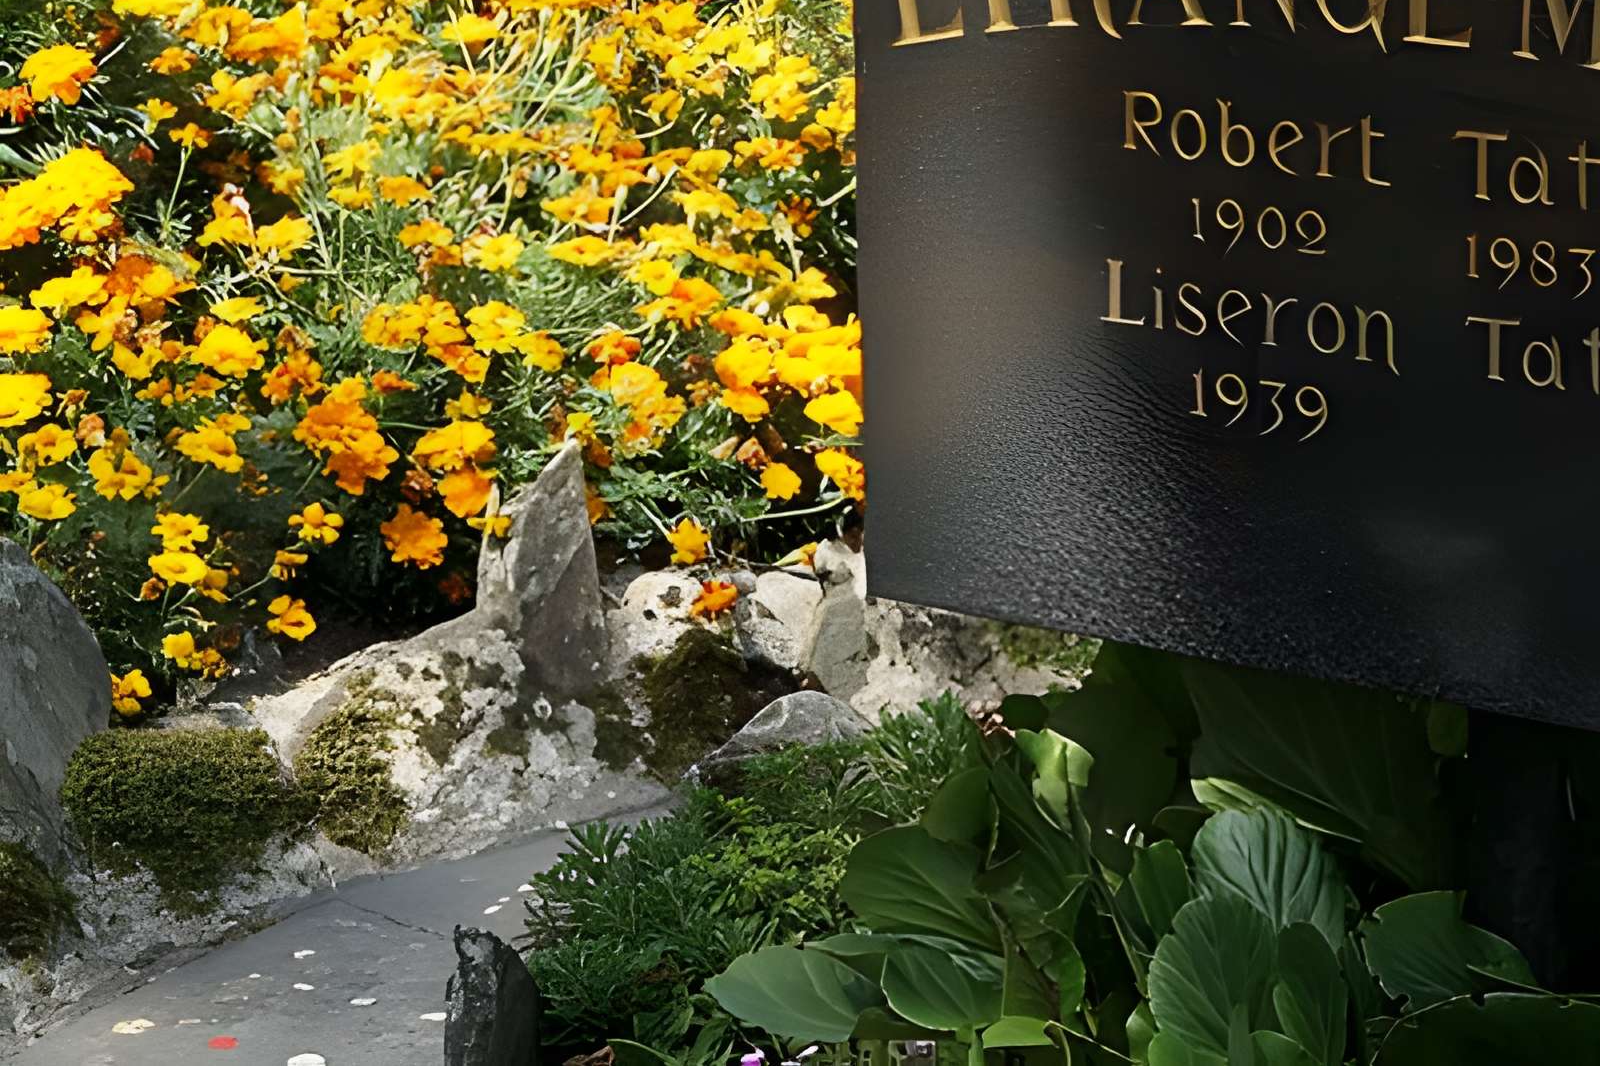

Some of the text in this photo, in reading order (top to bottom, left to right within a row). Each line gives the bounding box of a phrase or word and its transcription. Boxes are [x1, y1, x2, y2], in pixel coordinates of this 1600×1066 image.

[1122, 90, 1391, 186] Robert
[1191, 197, 1595, 299] 1902 1983
[1100, 258, 1399, 375] Liseron
[1189, 369, 1328, 442] 1939
